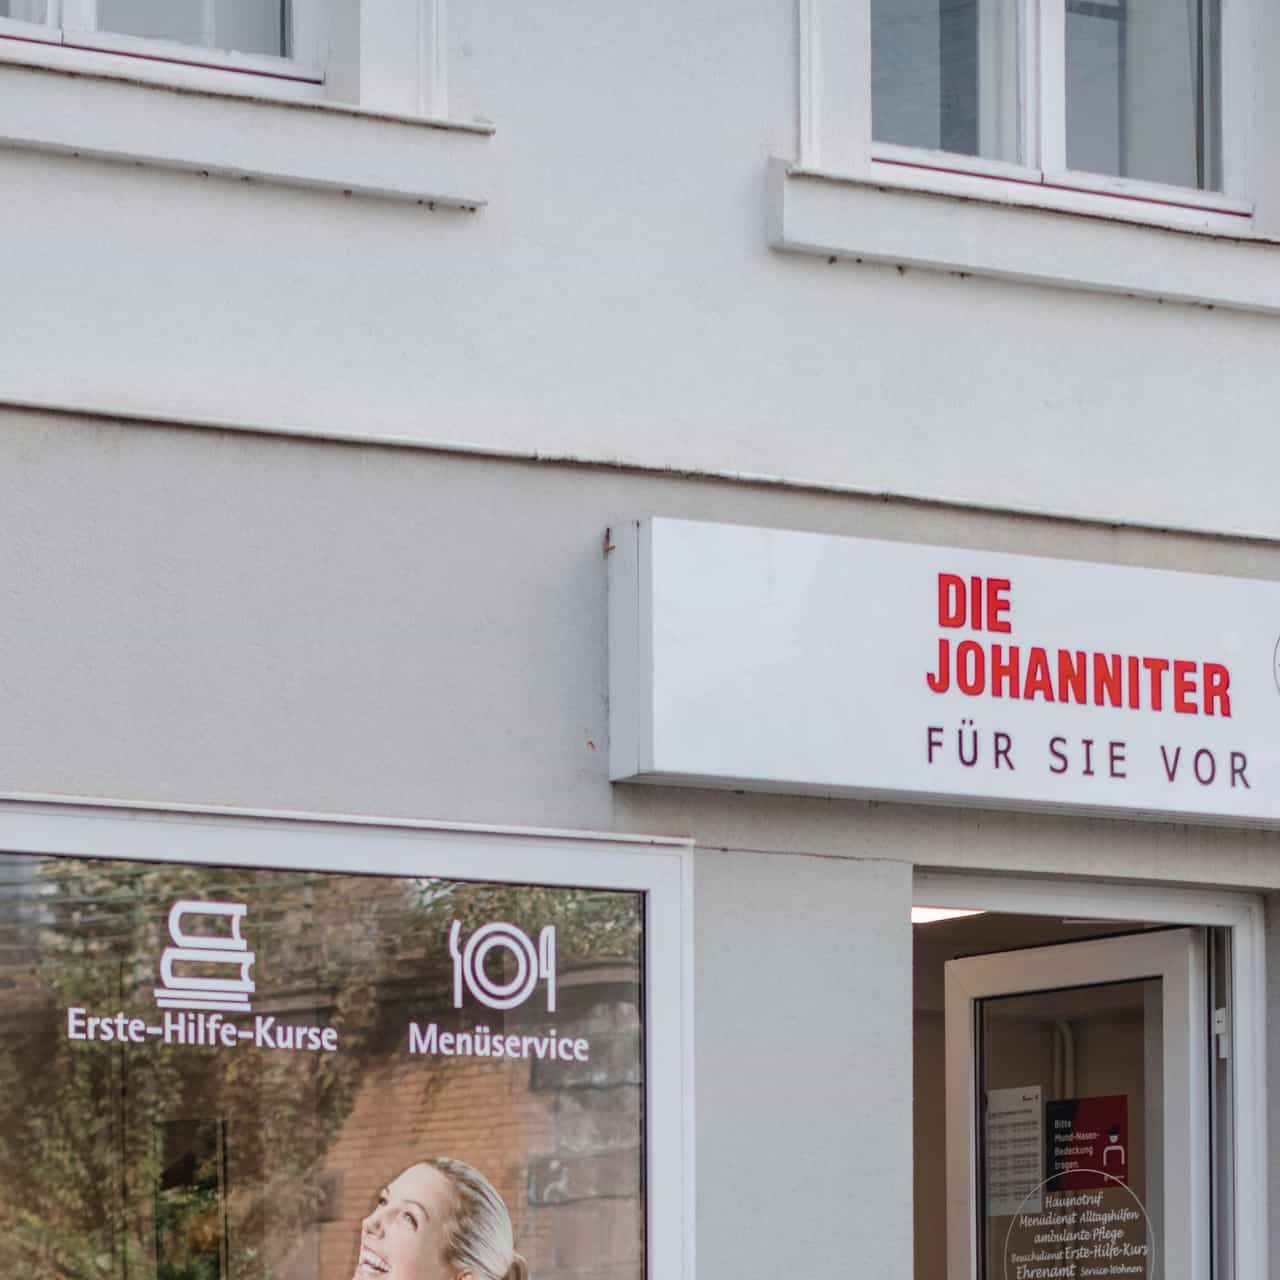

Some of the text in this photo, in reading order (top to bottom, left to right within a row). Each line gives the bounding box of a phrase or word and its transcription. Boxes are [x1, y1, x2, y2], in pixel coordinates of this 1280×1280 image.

[937, 572, 1012, 633] DIE
[926, 638, 1231, 717] JOHANNITER
[927, 719, 1015, 770] FÜR
[1049, 736, 1127, 779] SIE
[1161, 745, 1251, 789] VOR
[67, 1007, 339, 1054] Erste-Hilfe-Kurse
[409, 1021, 591, 1064] Menüservice
[1045, 1191, 1104, 1208] Hausnotruf
[1080, 1208, 1139, 1225] Alltagshilfen
[1034, 1226, 1124, 1244] ambulante Pflege
[1016, 1264, 1077, 1280] Ehrenamt
